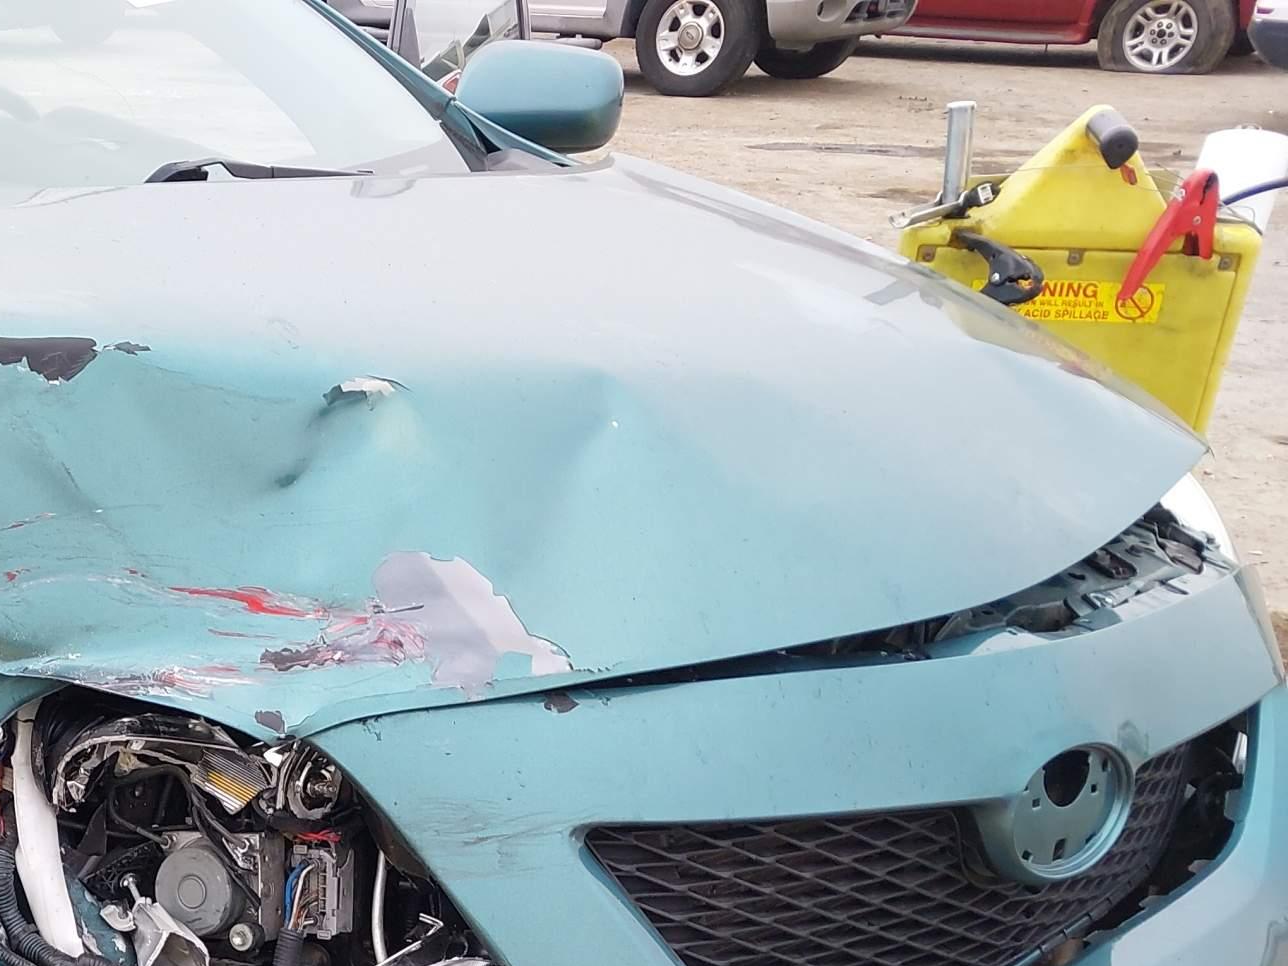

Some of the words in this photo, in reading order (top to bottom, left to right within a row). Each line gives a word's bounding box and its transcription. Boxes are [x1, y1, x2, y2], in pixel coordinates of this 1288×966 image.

[1061, 300, 1093, 308] RESULT
[1024, 308, 1051, 318] ACID
[1054, 309, 1109, 320] SPILLAGE
